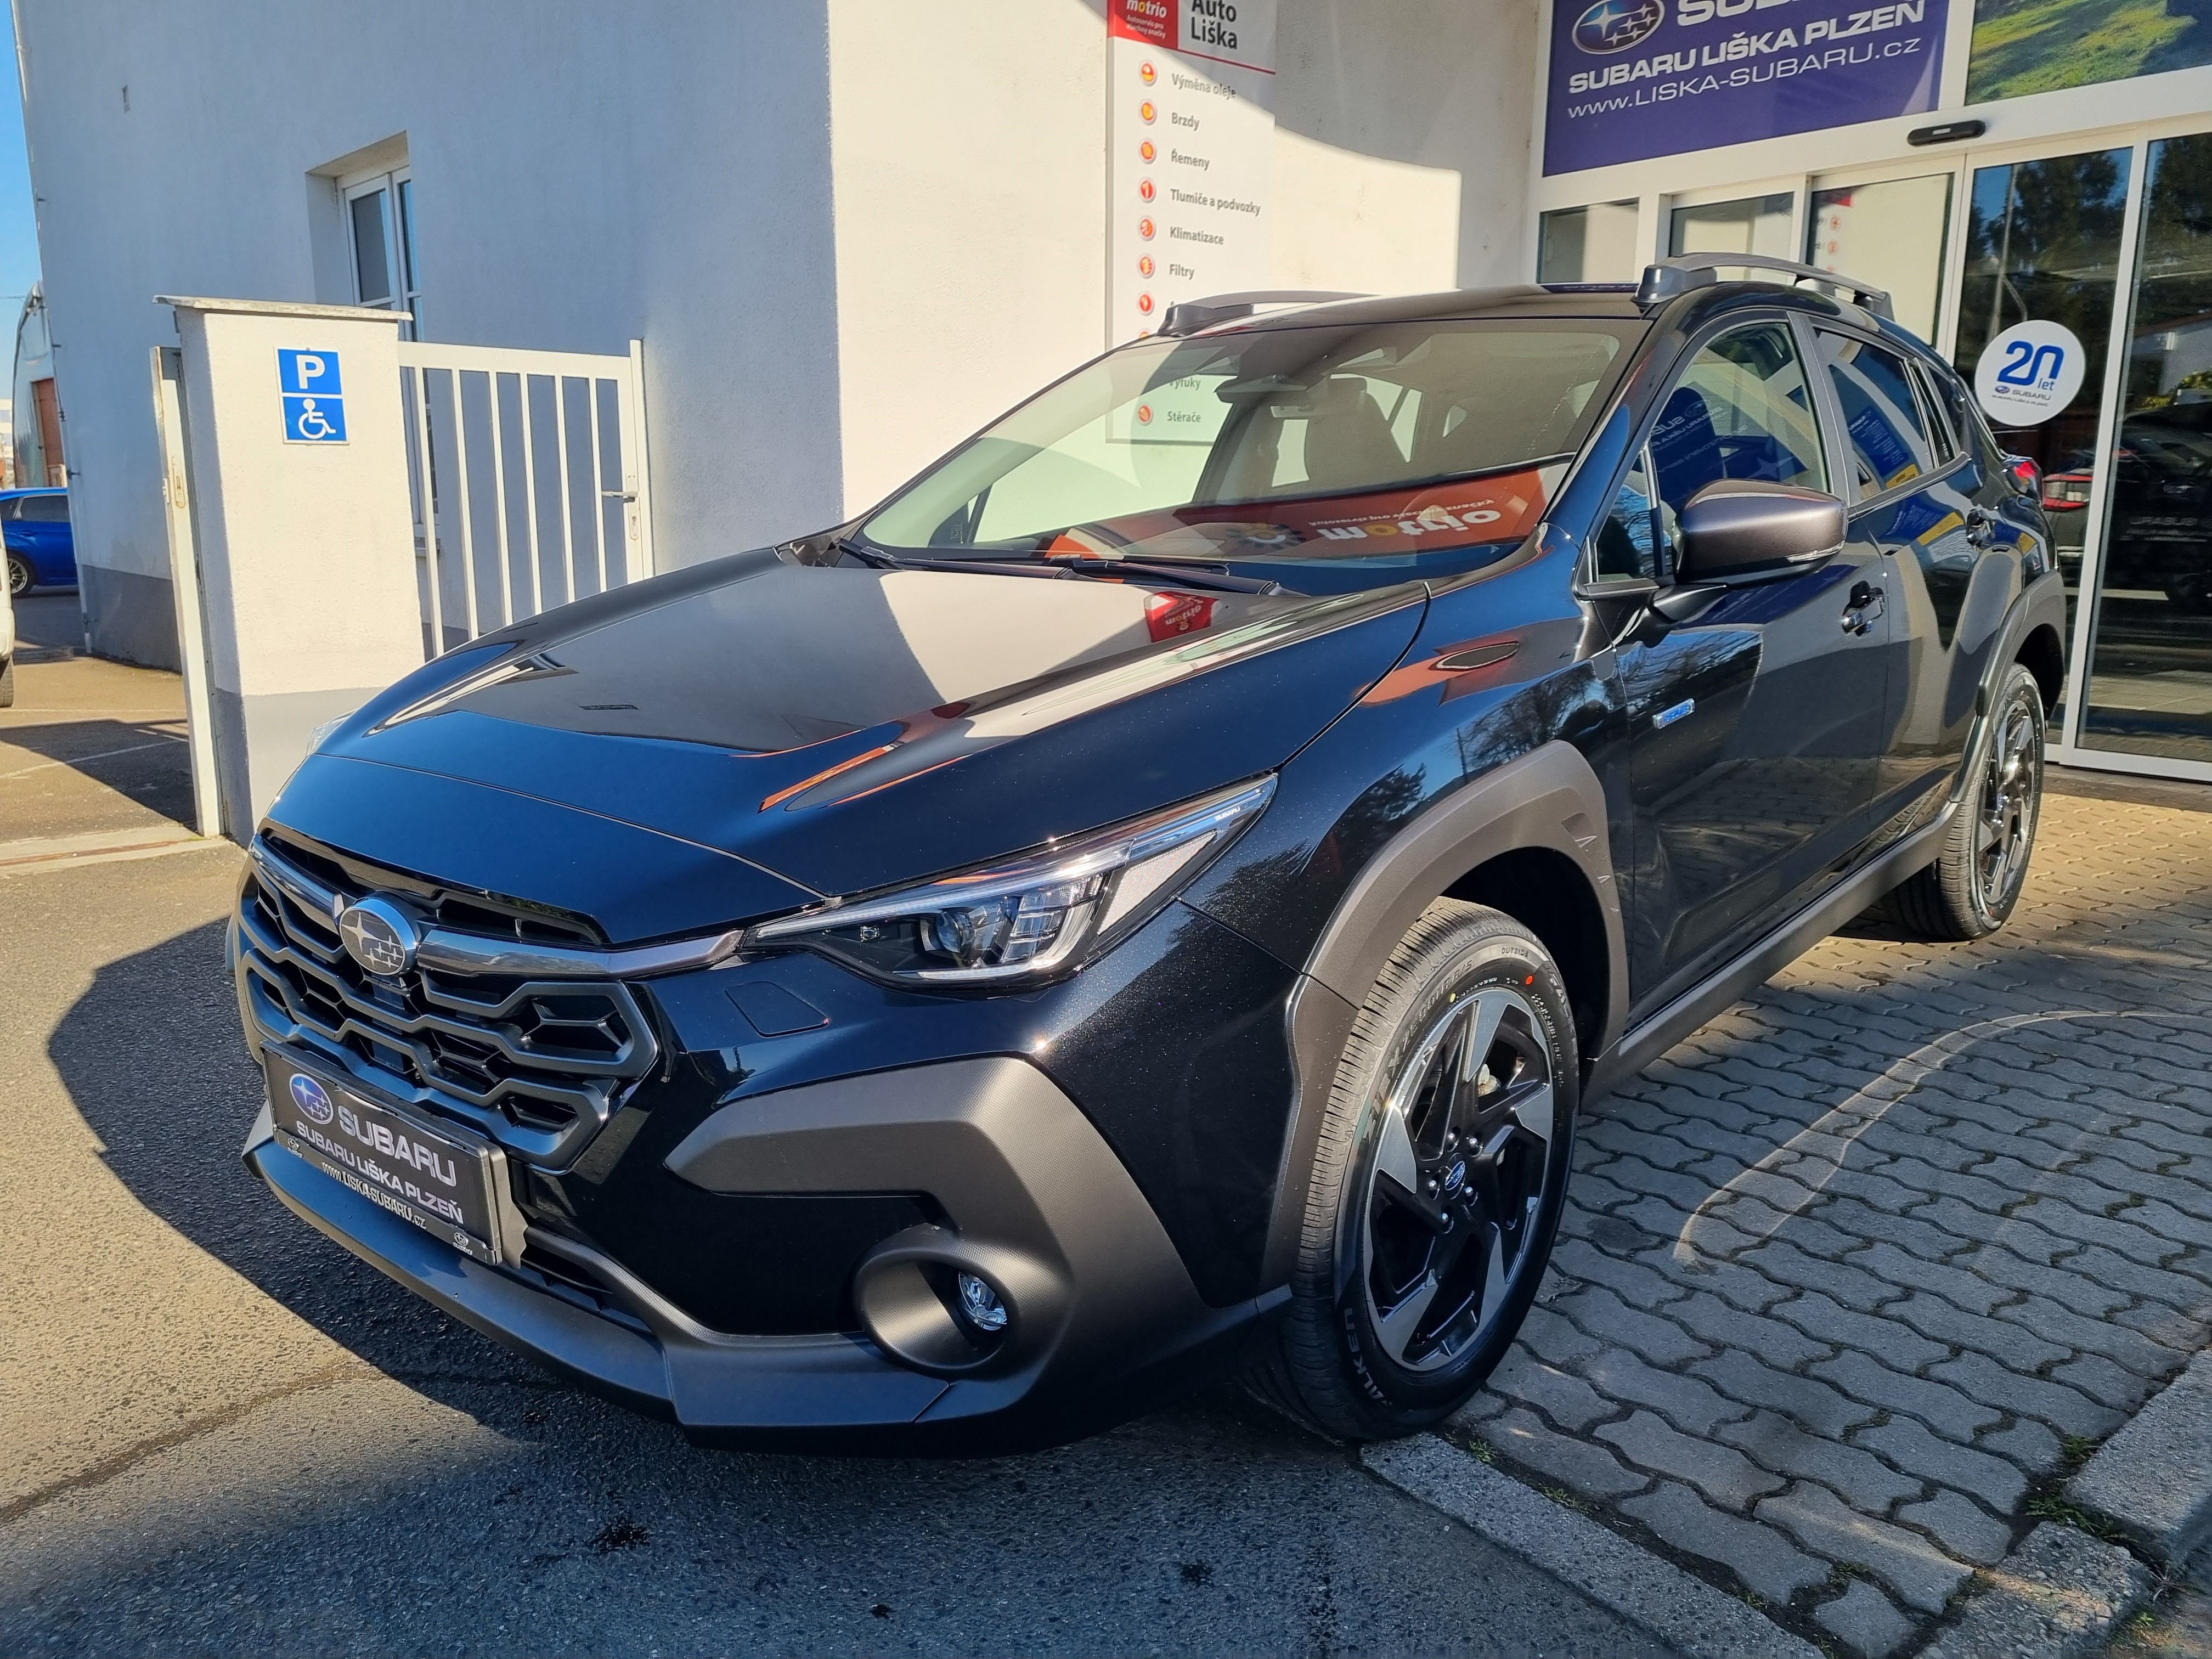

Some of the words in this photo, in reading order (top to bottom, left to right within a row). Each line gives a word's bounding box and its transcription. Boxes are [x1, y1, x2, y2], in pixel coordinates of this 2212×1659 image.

[1126, 0, 1167, 18] motrio
[1191, 0, 1238, 22] Auto
[1190, 16, 1238, 49] Liška
[1568, 48, 1697, 94] SUBARU
[1701, 31, 1798, 66] LIŠKA
[1171, 72, 1211, 93] Výměna
[1212, 82, 1237, 100] oleje
[1568, 38, 1921, 119] www.LISKA-SUBARU.cz
[1171, 112, 1200, 131] Brzdy
[1171, 148, 1210, 171] Řemeny
[1170, 189, 1208, 206] Tlumiče
[1209, 198, 1215, 207] a
[1216, 198, 1261, 217] podvozky
[1170, 226, 1224, 245] Klimatizace
[1169, 264, 1195, 280] Filtry
[296, 354, 325, 389] P
[2012, 390, 2051, 400] SUBARU
[2037, 378, 2055, 391] let
[1167, 411, 1201, 422] Stěrače
[338, 1104, 457, 1187] SUBARU
[296, 1120, 356, 1167] SUBARU
[356, 1154, 405, 1194] LIŠKA
[407, 1182, 464, 1224] PLZEŇ
